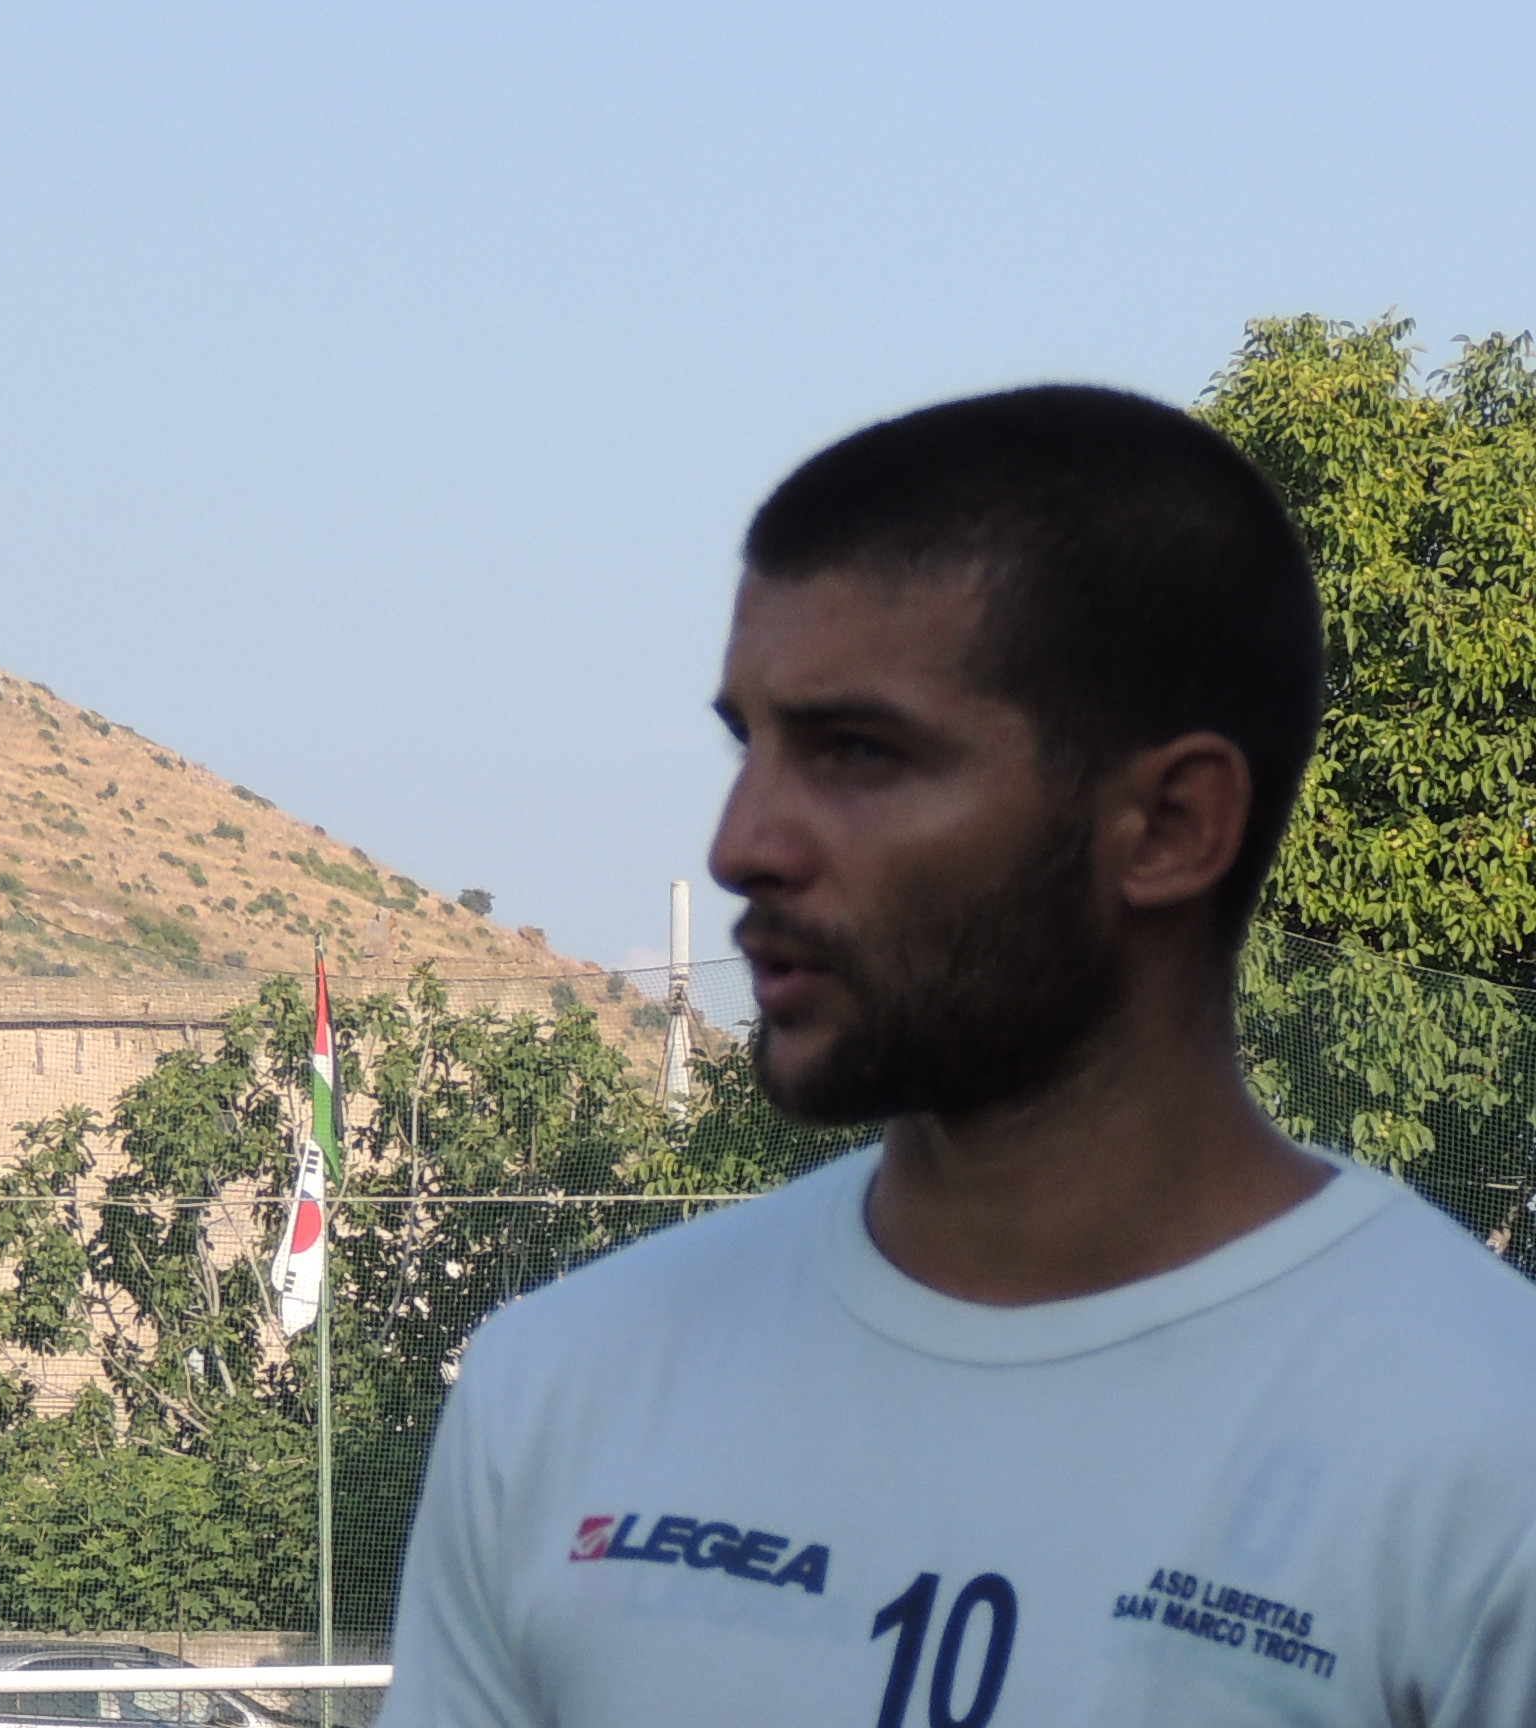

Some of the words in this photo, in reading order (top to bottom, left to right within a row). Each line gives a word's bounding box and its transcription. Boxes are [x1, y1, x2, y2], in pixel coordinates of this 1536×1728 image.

[603, 1512, 830, 1595] LEGEA
[1112, 1594, 1159, 1622] SAN
[1161, 1600, 1247, 1648] MARCO
[1252, 1626, 1337, 1680] TROTTI
[1148, 1567, 1198, 1601] ASD
[1202, 1581, 1314, 1638] LIBERTAS
